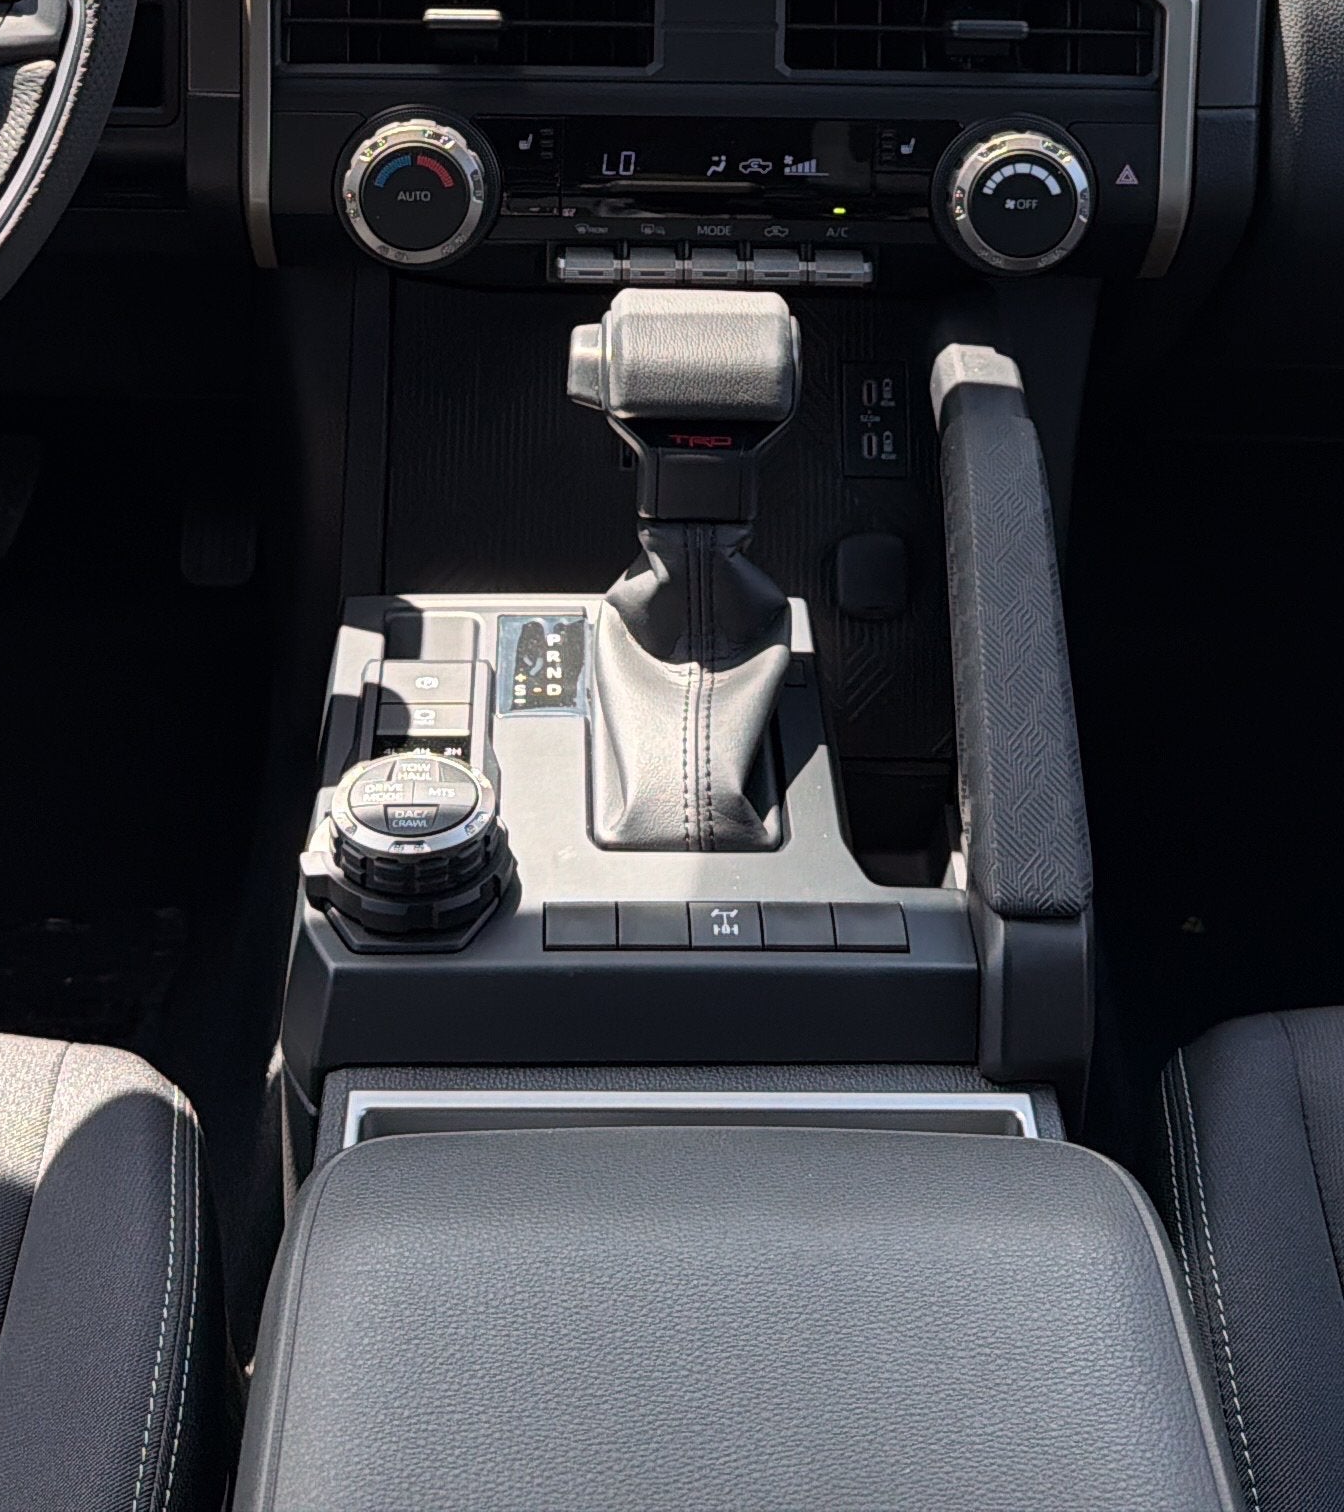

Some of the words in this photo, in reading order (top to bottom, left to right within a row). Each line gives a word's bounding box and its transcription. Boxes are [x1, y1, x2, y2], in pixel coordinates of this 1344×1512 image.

[397, 191, 431, 202] AUTO
[1016, 199, 1038, 209] OFF
[697, 225, 731, 236] MODE
[826, 226, 849, 237] A/C
[668, 435, 733, 448] TRD
[546, 633, 561, 646] P
[546, 650, 561, 663] R
[546, 666, 563, 679] N
[514, 684, 526, 696] S
[546, 683, 563, 696] D
[443, 747, 462, 756] 2H
[401, 763, 431, 773] TOW
[398, 772, 432, 781] HAUL
[364, 783, 404, 793] DRIVE
[428, 787, 456, 798] MTS
[394, 810, 427, 820] DAC/
[392, 819, 428, 828] CRAWL
